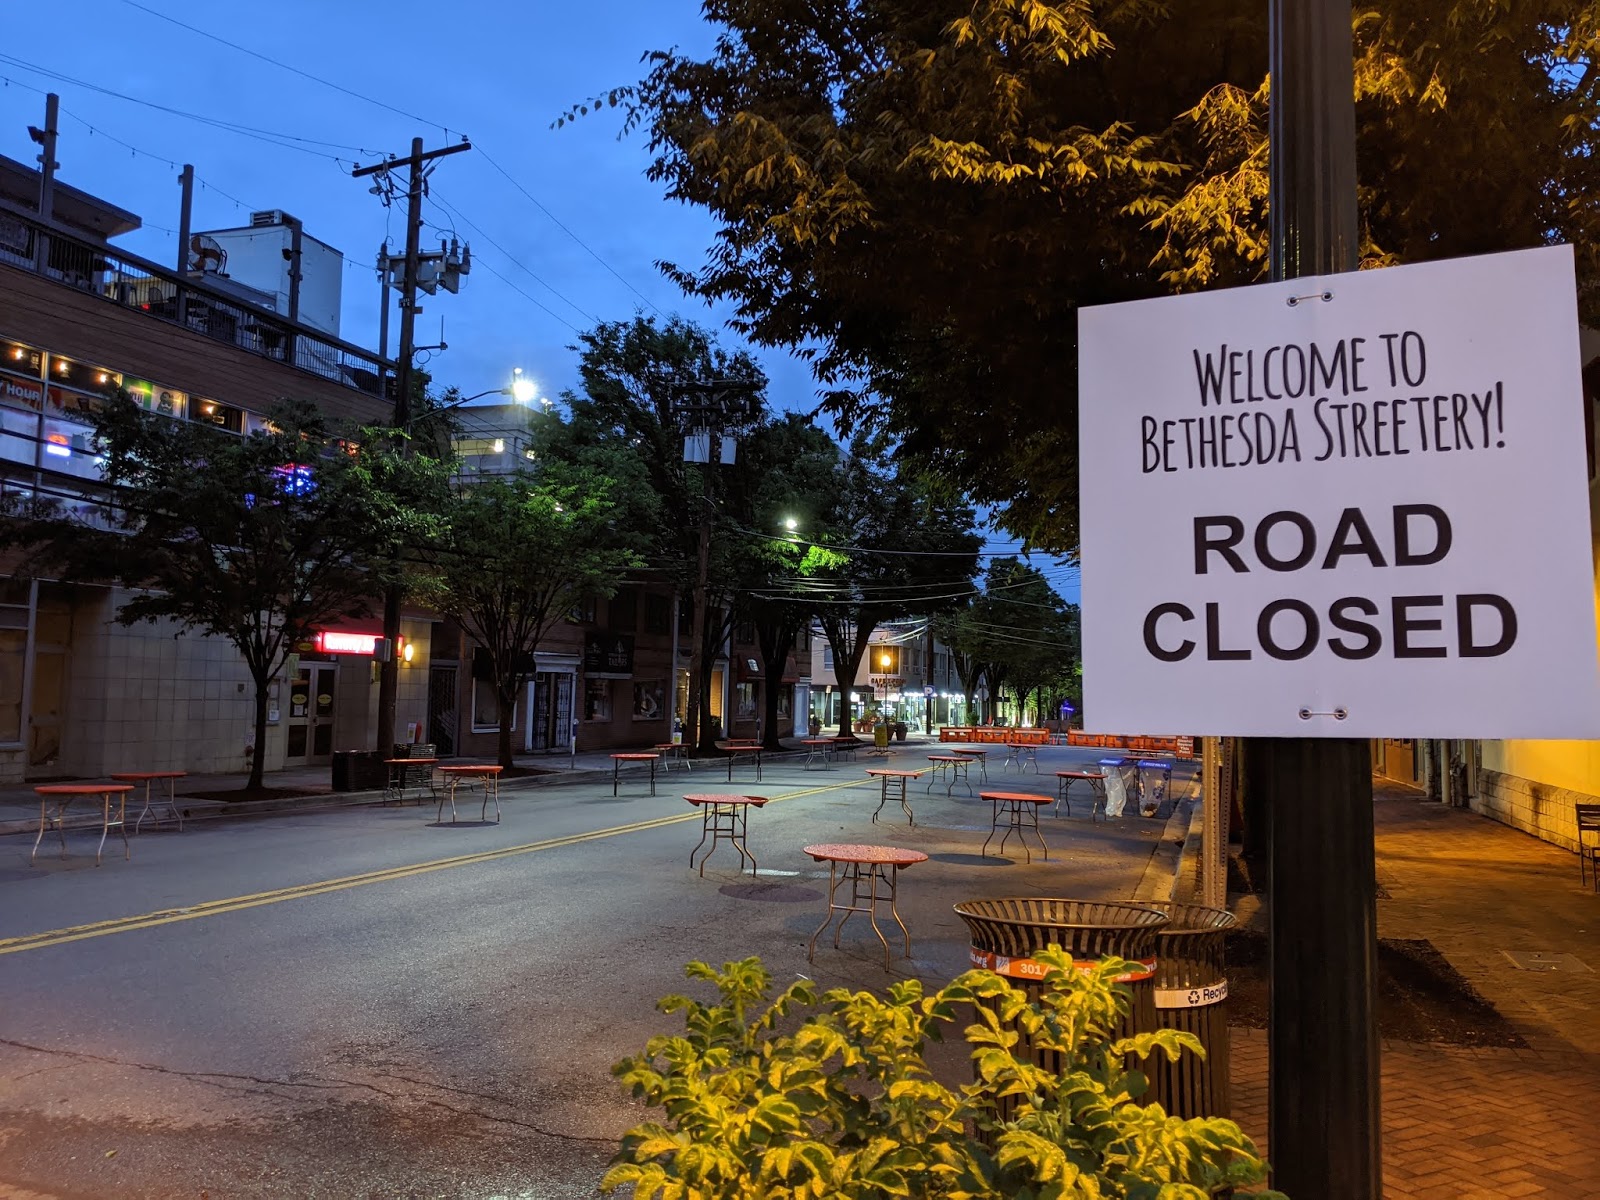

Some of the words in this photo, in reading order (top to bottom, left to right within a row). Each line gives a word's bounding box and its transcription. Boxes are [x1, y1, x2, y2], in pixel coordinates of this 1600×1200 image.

[6, 383, 40, 400] HOUR
[1378, 330, 1427, 388] TO
[1141, 407, 1302, 474] BETHESDA
[1193, 503, 1453, 575] ROAD
[1142, 593, 1518, 663] CLOSED
